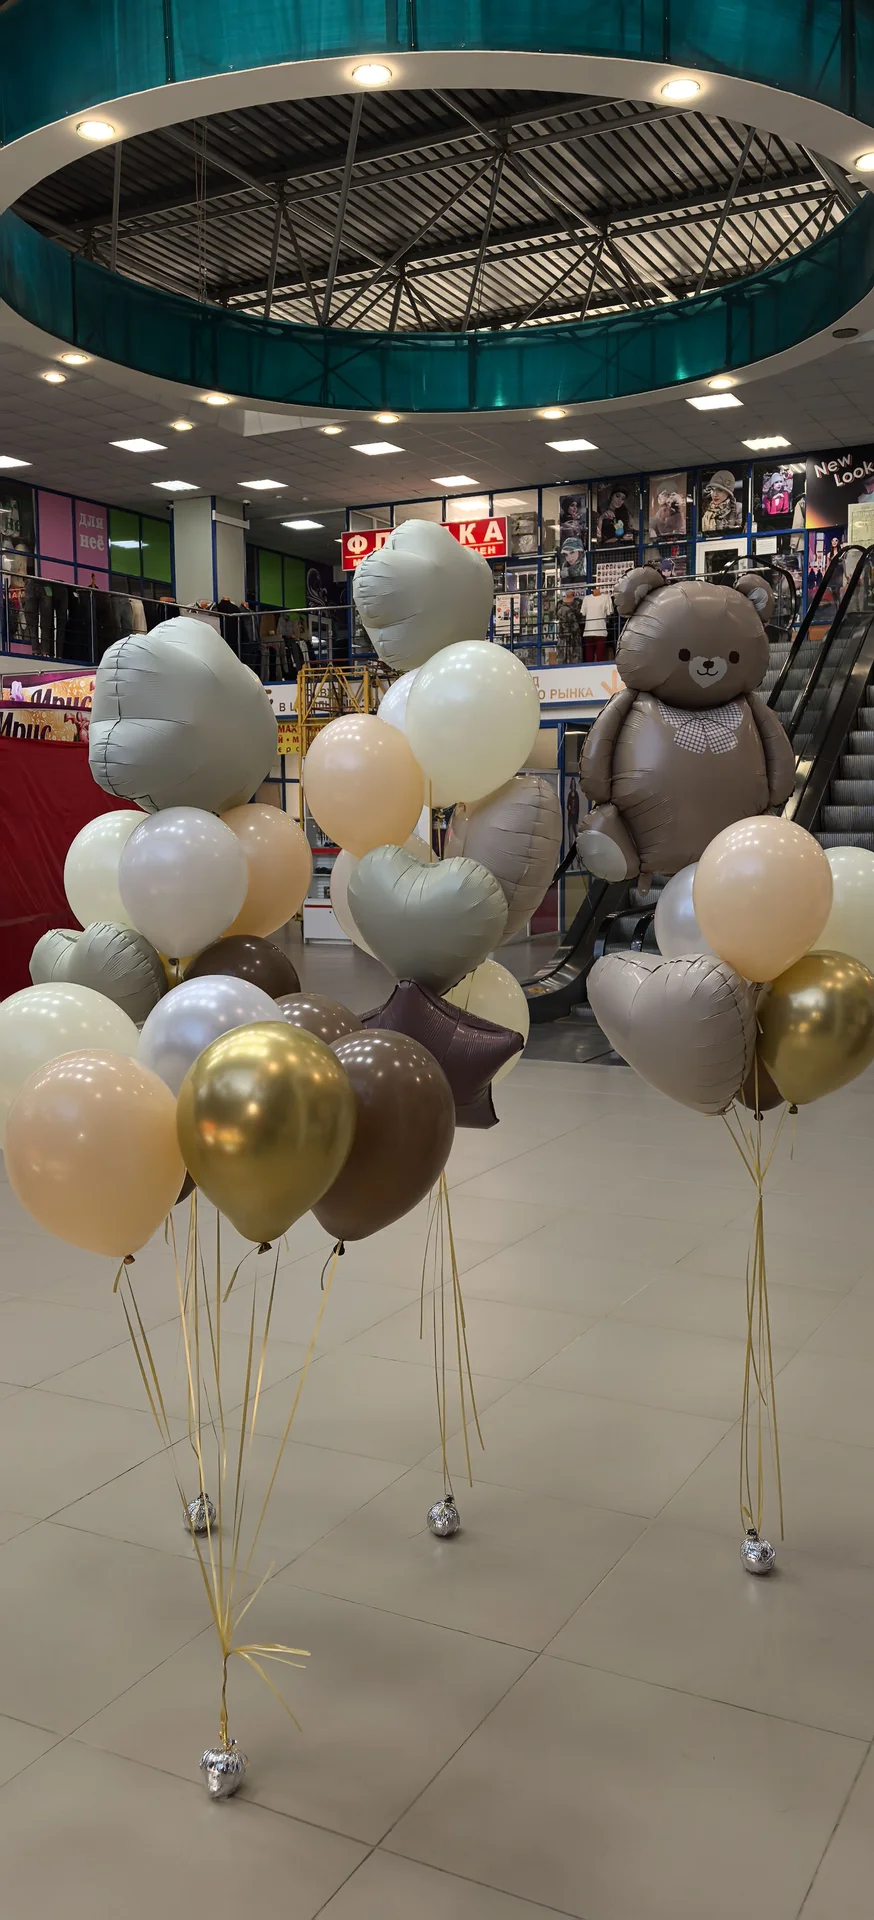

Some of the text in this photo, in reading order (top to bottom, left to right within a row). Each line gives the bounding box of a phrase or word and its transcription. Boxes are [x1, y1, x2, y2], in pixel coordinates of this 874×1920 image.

[814, 454, 852, 479] New
[834, 461, 874, 487] Look
[79, 513, 104, 530] для
[79, 533, 105, 552] неё
[550, 687, 593, 699] РЫНКА
